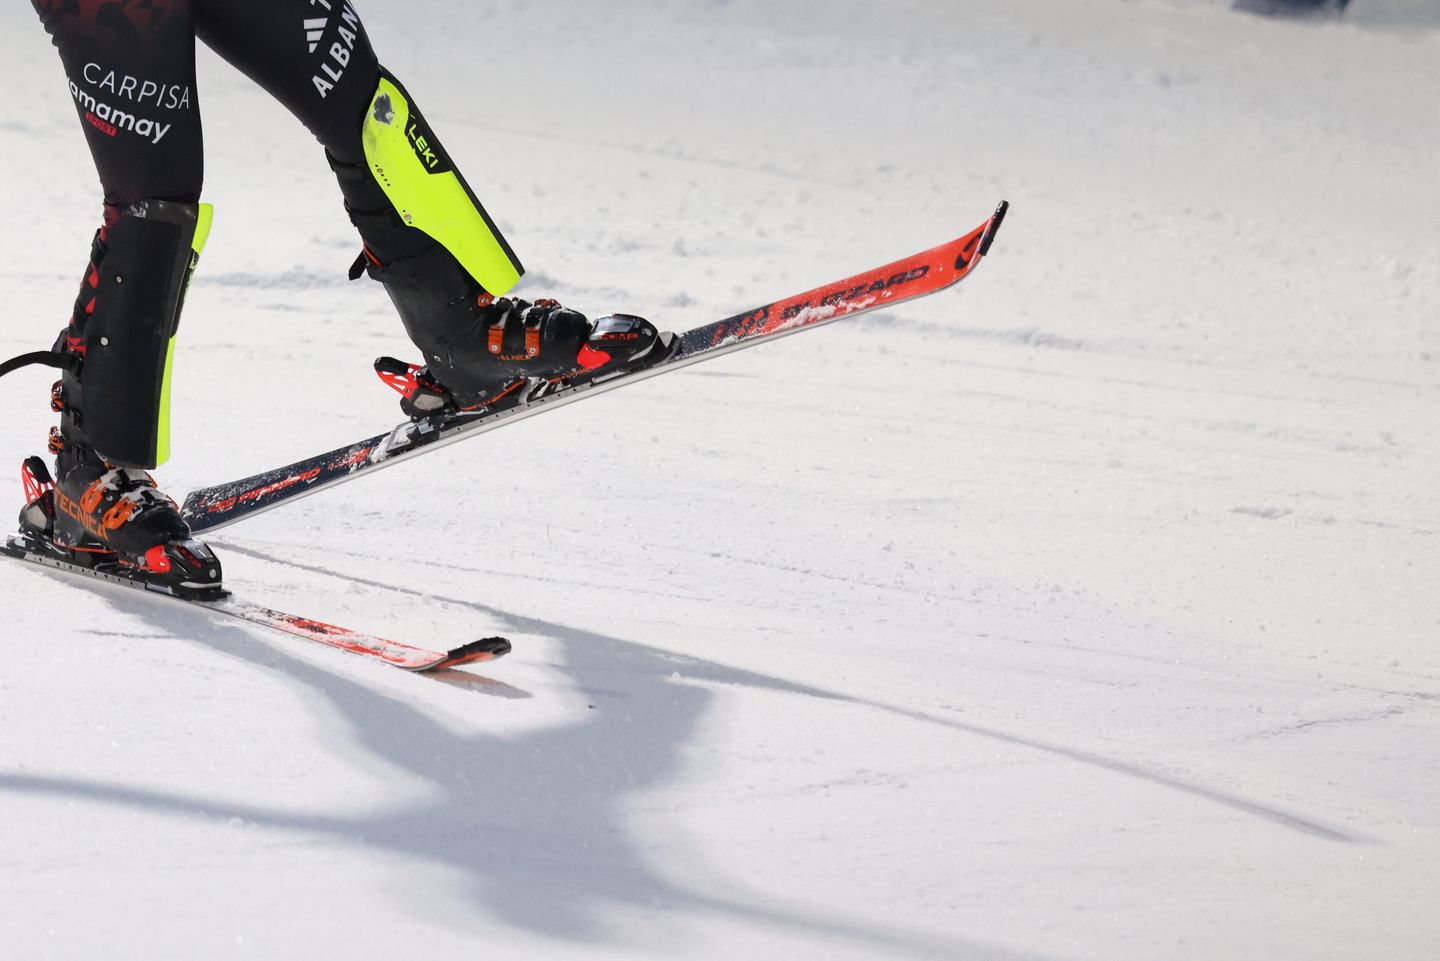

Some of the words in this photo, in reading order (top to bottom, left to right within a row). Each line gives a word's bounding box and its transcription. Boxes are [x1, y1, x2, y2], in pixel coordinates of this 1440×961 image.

[83, 62, 190, 110] CARPISA
[407, 123, 439, 169] LEKI
[54, 489, 110, 541] TECNICA
